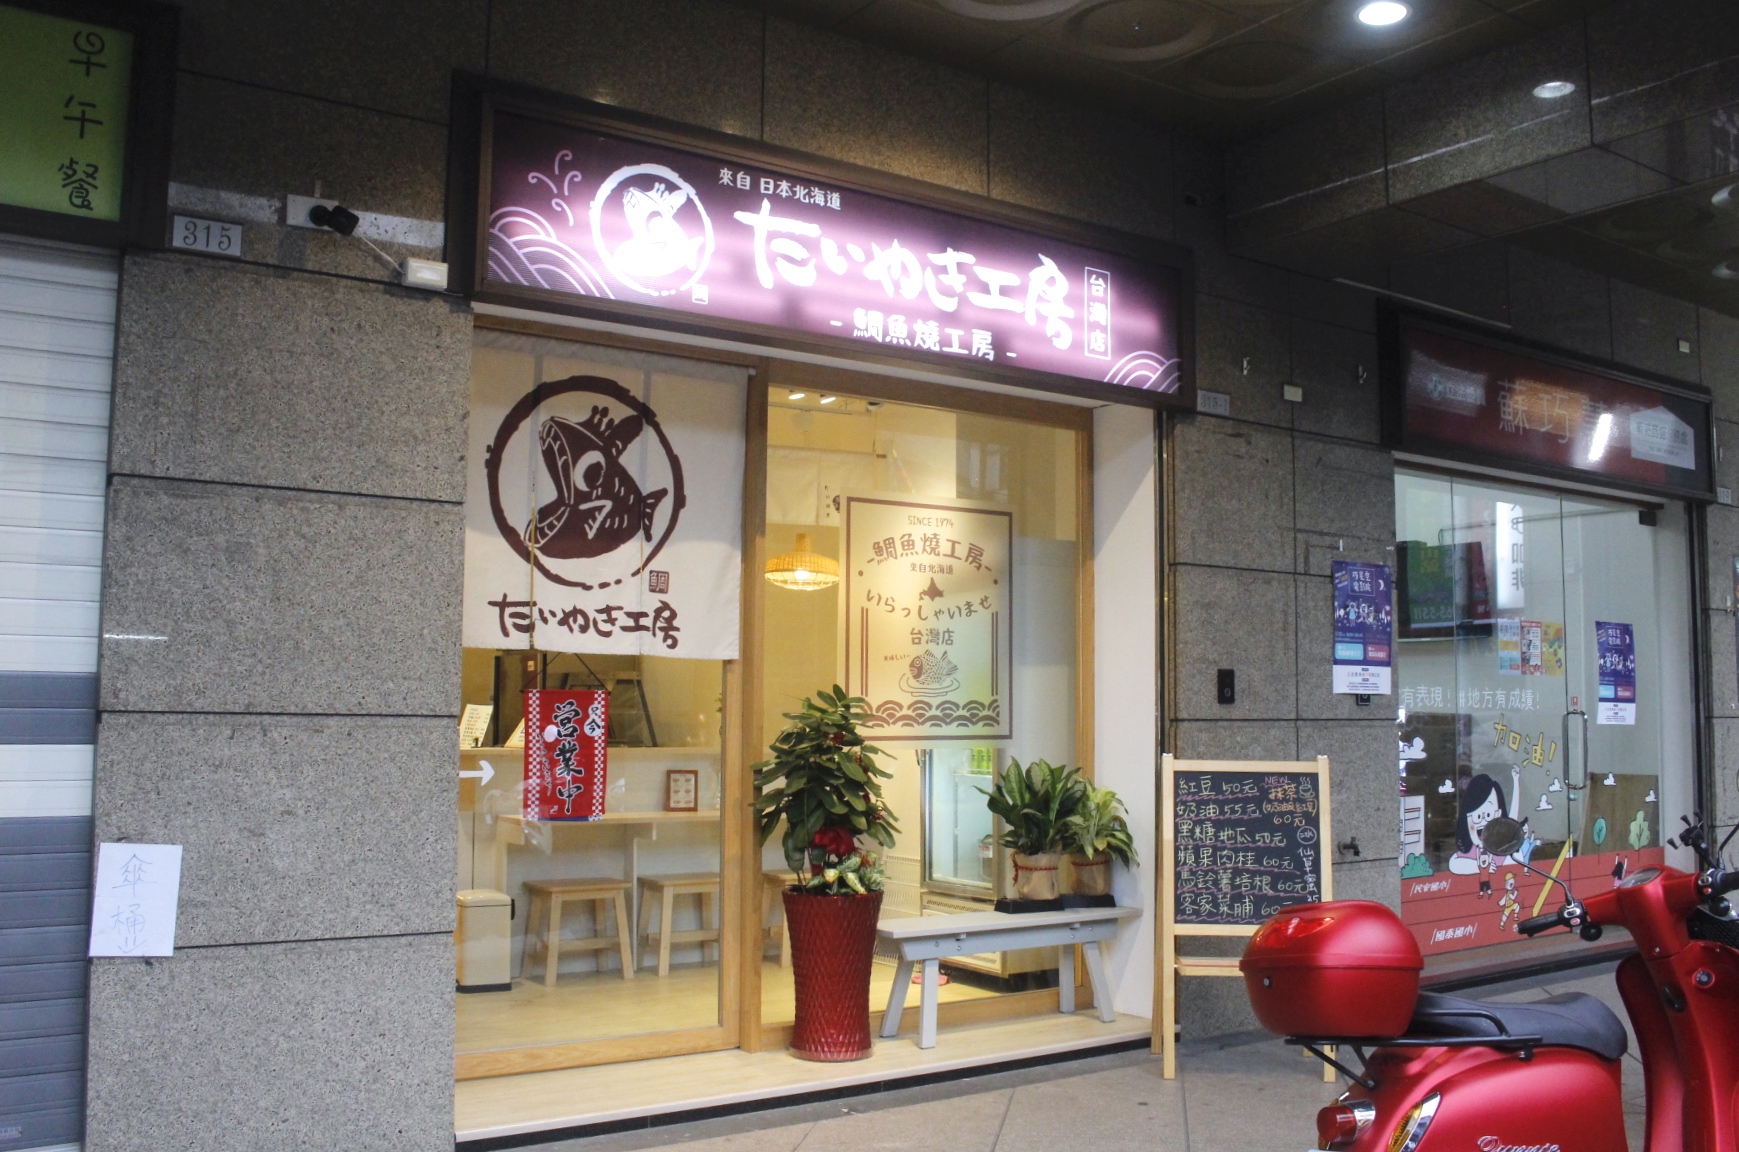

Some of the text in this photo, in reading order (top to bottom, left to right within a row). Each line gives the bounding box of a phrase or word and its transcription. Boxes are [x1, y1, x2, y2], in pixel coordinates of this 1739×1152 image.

[58, 31, 107, 211] 早午餐
[719, 167, 841, 210] 來自 日本北海道
[183, 220, 233, 251] 315
[733, 197, 1075, 351] たいやき工房
[1089, 274, 1108, 353] 台灣店
[853, 307, 995, 361] 鯛魚燒工房
[907, 515, 954, 529] SINCE 1974
[872, 532, 985, 572] 鯛魚燒工房
[910, 562, 954, 576] 來自北海道
[867, 589, 992, 621] いらっしゃいませ
[487, 592, 681, 650] たいやき工房
[910, 627, 955, 646] 台灣店
[1493, 713, 1557, 776] 加油!
[1178, 775, 1258, 795] 紅豆 50元
[1264, 775, 1288, 785] NEW
[1268, 783, 1297, 800] 抹茶
[1176, 802, 1259, 818] 奶油 55元
[1273, 813, 1305, 827] 60元
[1177, 820, 1287, 846] 黑糖地瓜 50元
[1177, 845, 1294, 869] 蘋果肉桂 60元
[1177, 868, 1308, 894] 馬鈴薯培根 60元
[111, 853, 158, 936] 傘桶
[1179, 893, 1293, 919] 客家菜脯 60
